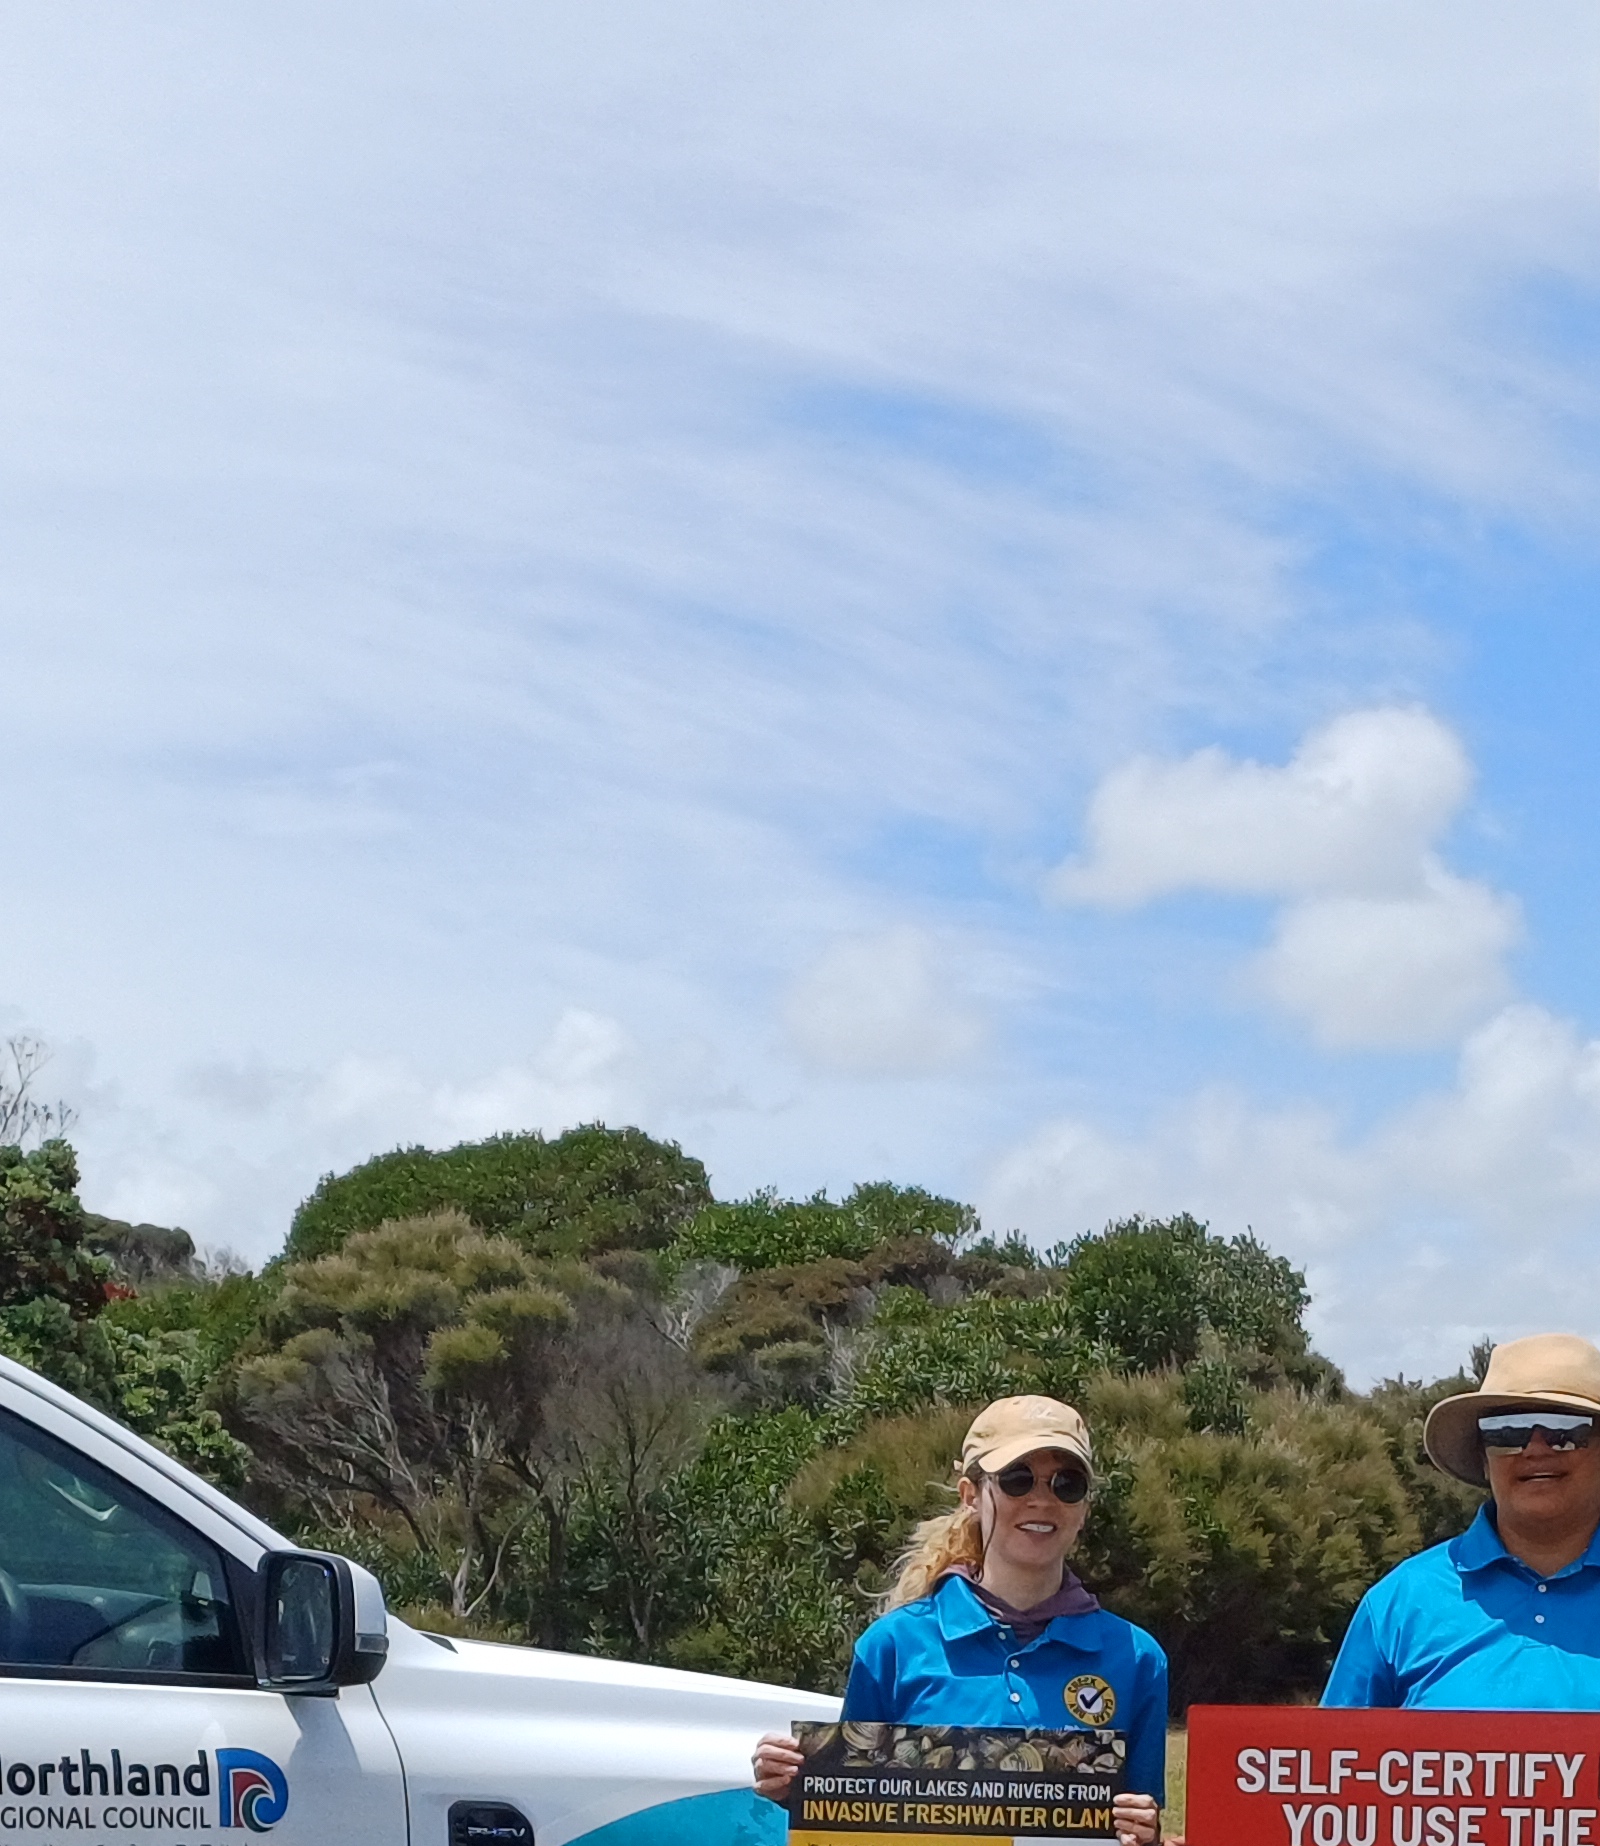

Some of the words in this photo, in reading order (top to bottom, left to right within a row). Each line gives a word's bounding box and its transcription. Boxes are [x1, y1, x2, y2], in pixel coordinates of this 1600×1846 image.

[1236, 1748, 1586, 1799] SELF-CERTIFY
[803, 1776, 875, 1796] PROTECT
[879, 1780, 911, 1797] OUR
[915, 1781, 968, 1798] LAKES
[971, 1782, 1004, 1799] AND
[1008, 1783, 1064, 1801] RIVERS
[1069, 1784, 1111, 1802] FROM
[102, 1806, 212, 1830] COUNCIL
[803, 1800, 898, 1824] INVASIVE
[903, 1803, 1047, 1828] FRESHWATER
[1053, 1807, 1110, 1830] CLAM
